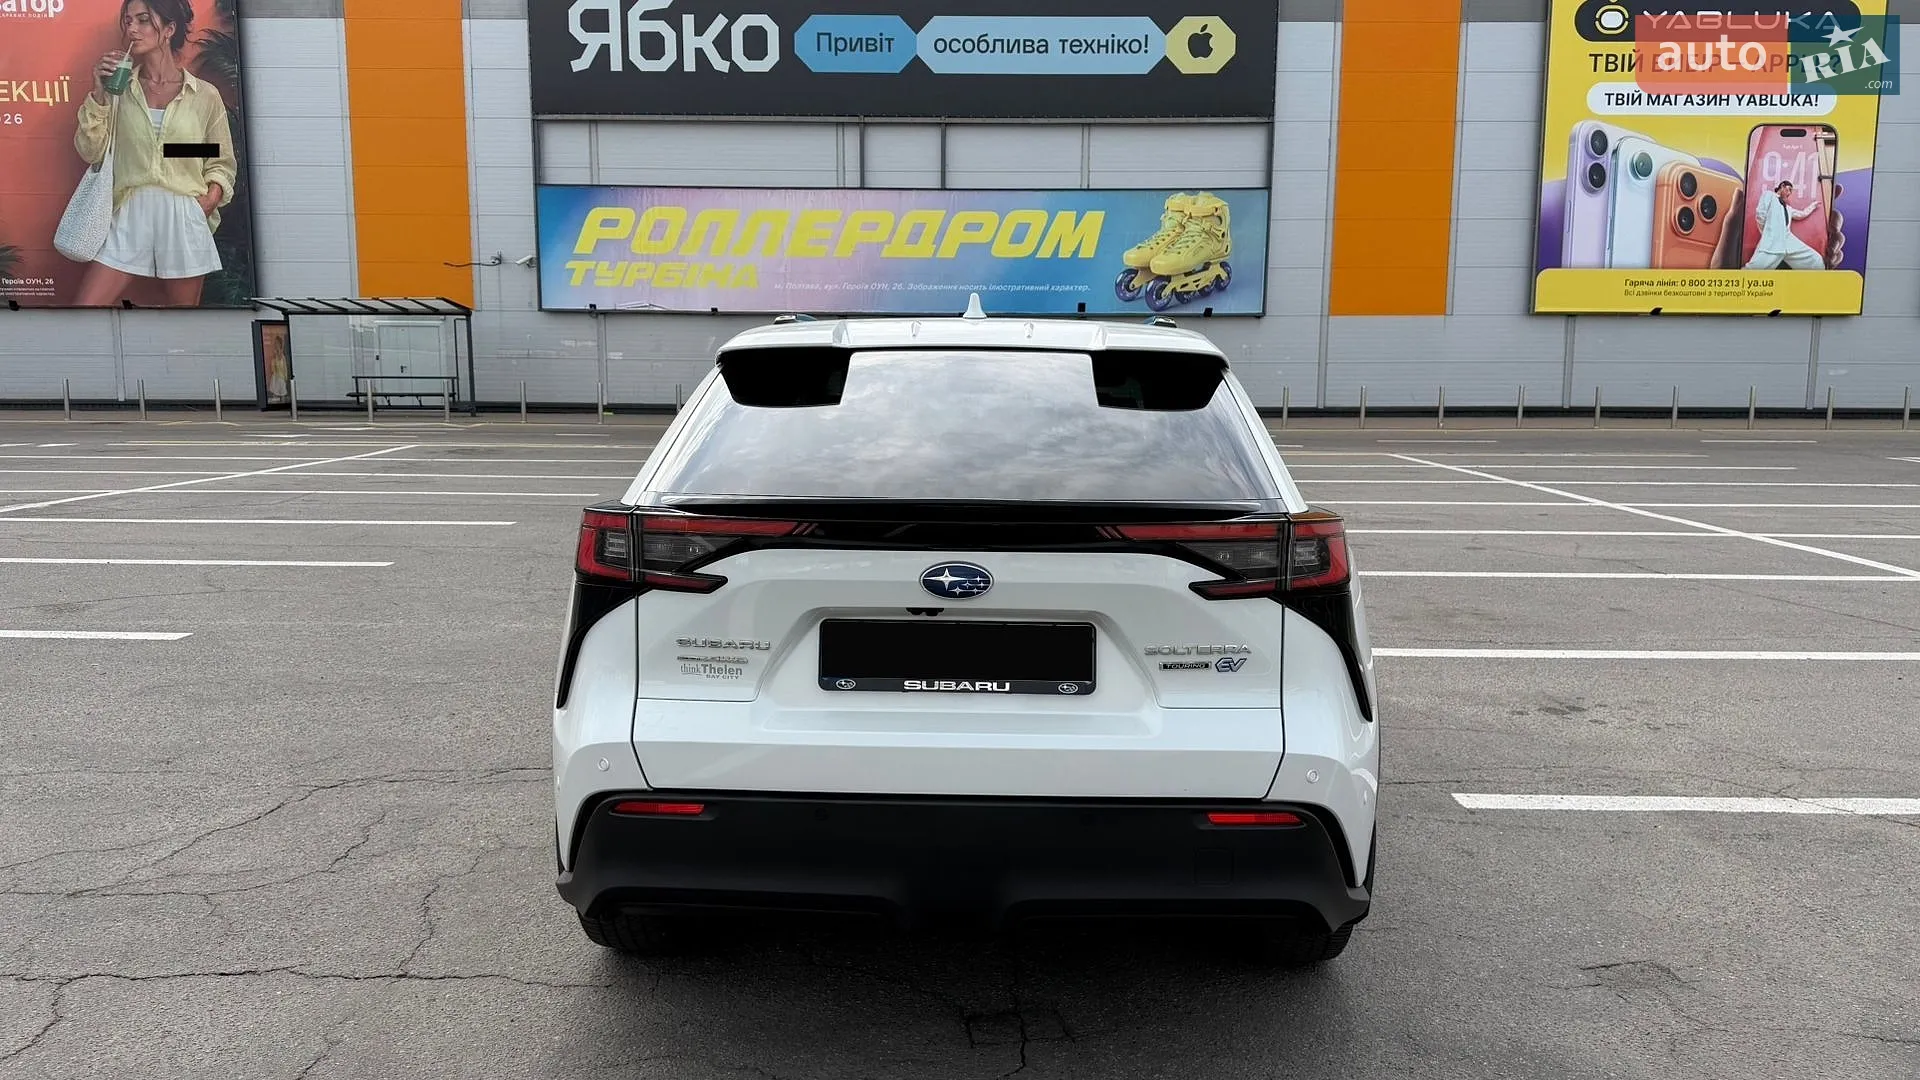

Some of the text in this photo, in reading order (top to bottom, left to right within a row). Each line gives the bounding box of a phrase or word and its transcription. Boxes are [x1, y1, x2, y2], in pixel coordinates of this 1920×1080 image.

[0, 0, 64, 18] атор
[1642, 10, 1841, 30] YABLUKA
[568, 0, 780, 73] Ябко
[816, 33, 1149, 60] Привіт особлива техніко!
[1588, 48, 1643, 73] ТВІЙ
[1604, 90, 1819, 108] ТВІЙ МАГАЗИН YABLUKA!
[0, 112, 23, 125] 26
[572, 205, 1105, 260] РОЛЛЕРДРОМ
[565, 260, 760, 289] ТУРБІНА
[1625, 279, 1654, 288] Гаряча
[1656, 279, 1679, 287] лінія:
[1681, 279, 1686, 287] 0
[1689, 279, 1706, 287] 800
[1708, 279, 1722, 287] 213
[1725, 279, 1740, 287] 213
[1747, 279, 1774, 289] ya.ua
[676, 637, 771, 651] SUBARU
[1144, 644, 1252, 656] SOLTERRA
[702, 664, 742, 675] Thelen
[1215, 657, 1247, 672] EV
[903, 680, 1010, 691] SUBARU
